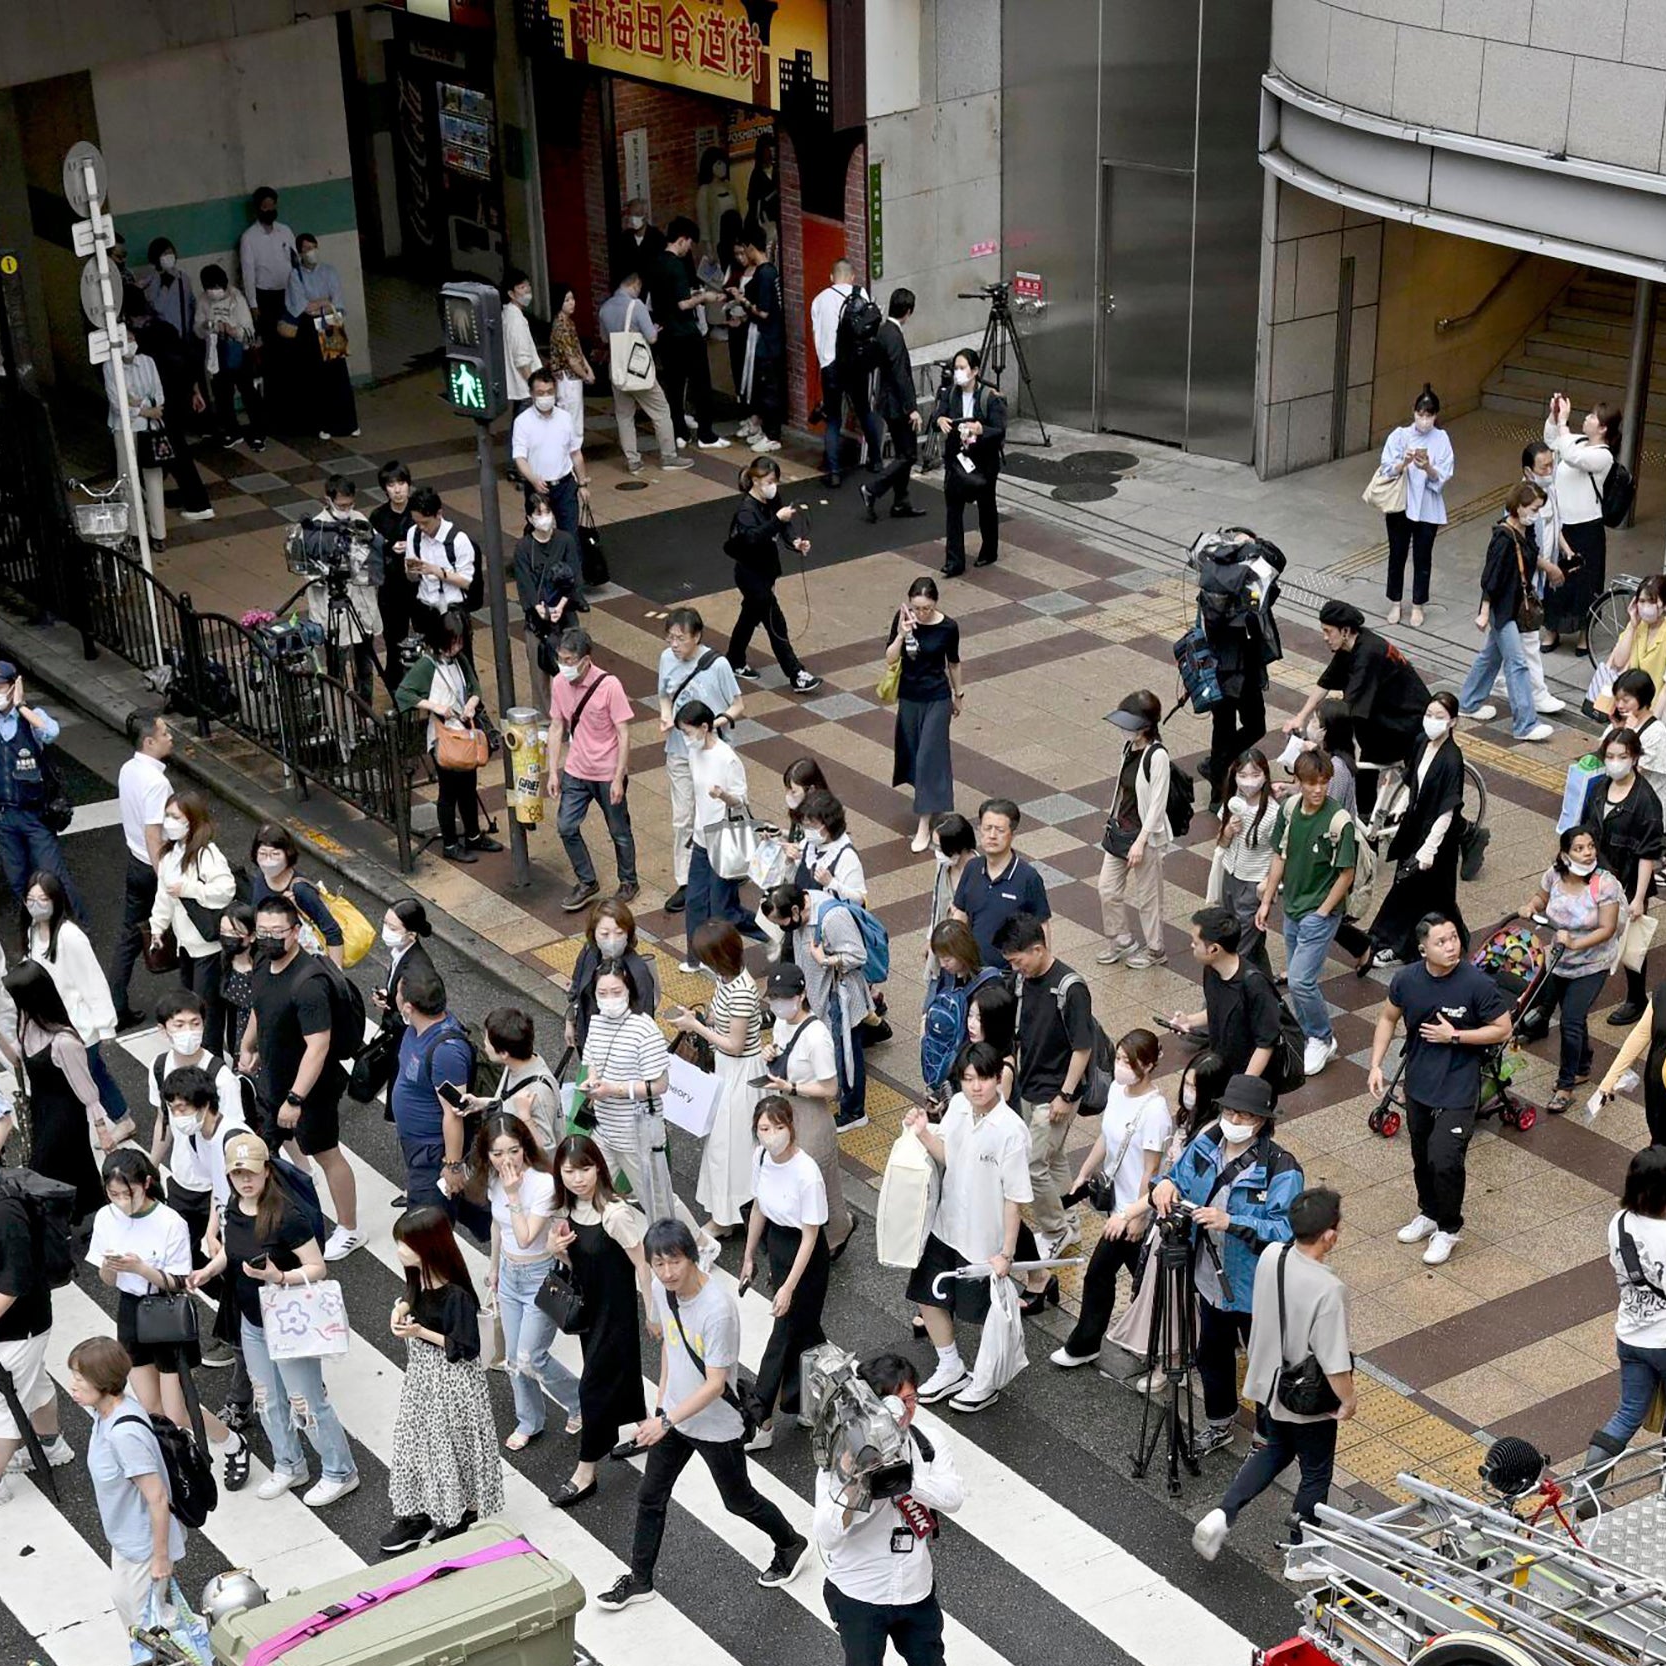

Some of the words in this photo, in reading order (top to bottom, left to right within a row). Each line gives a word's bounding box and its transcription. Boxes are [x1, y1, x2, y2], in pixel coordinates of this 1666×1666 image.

[571, 0, 761, 83] 新梅田食道街
[669, 1083, 694, 1104] eory
[903, 1498, 930, 1532] NHK
